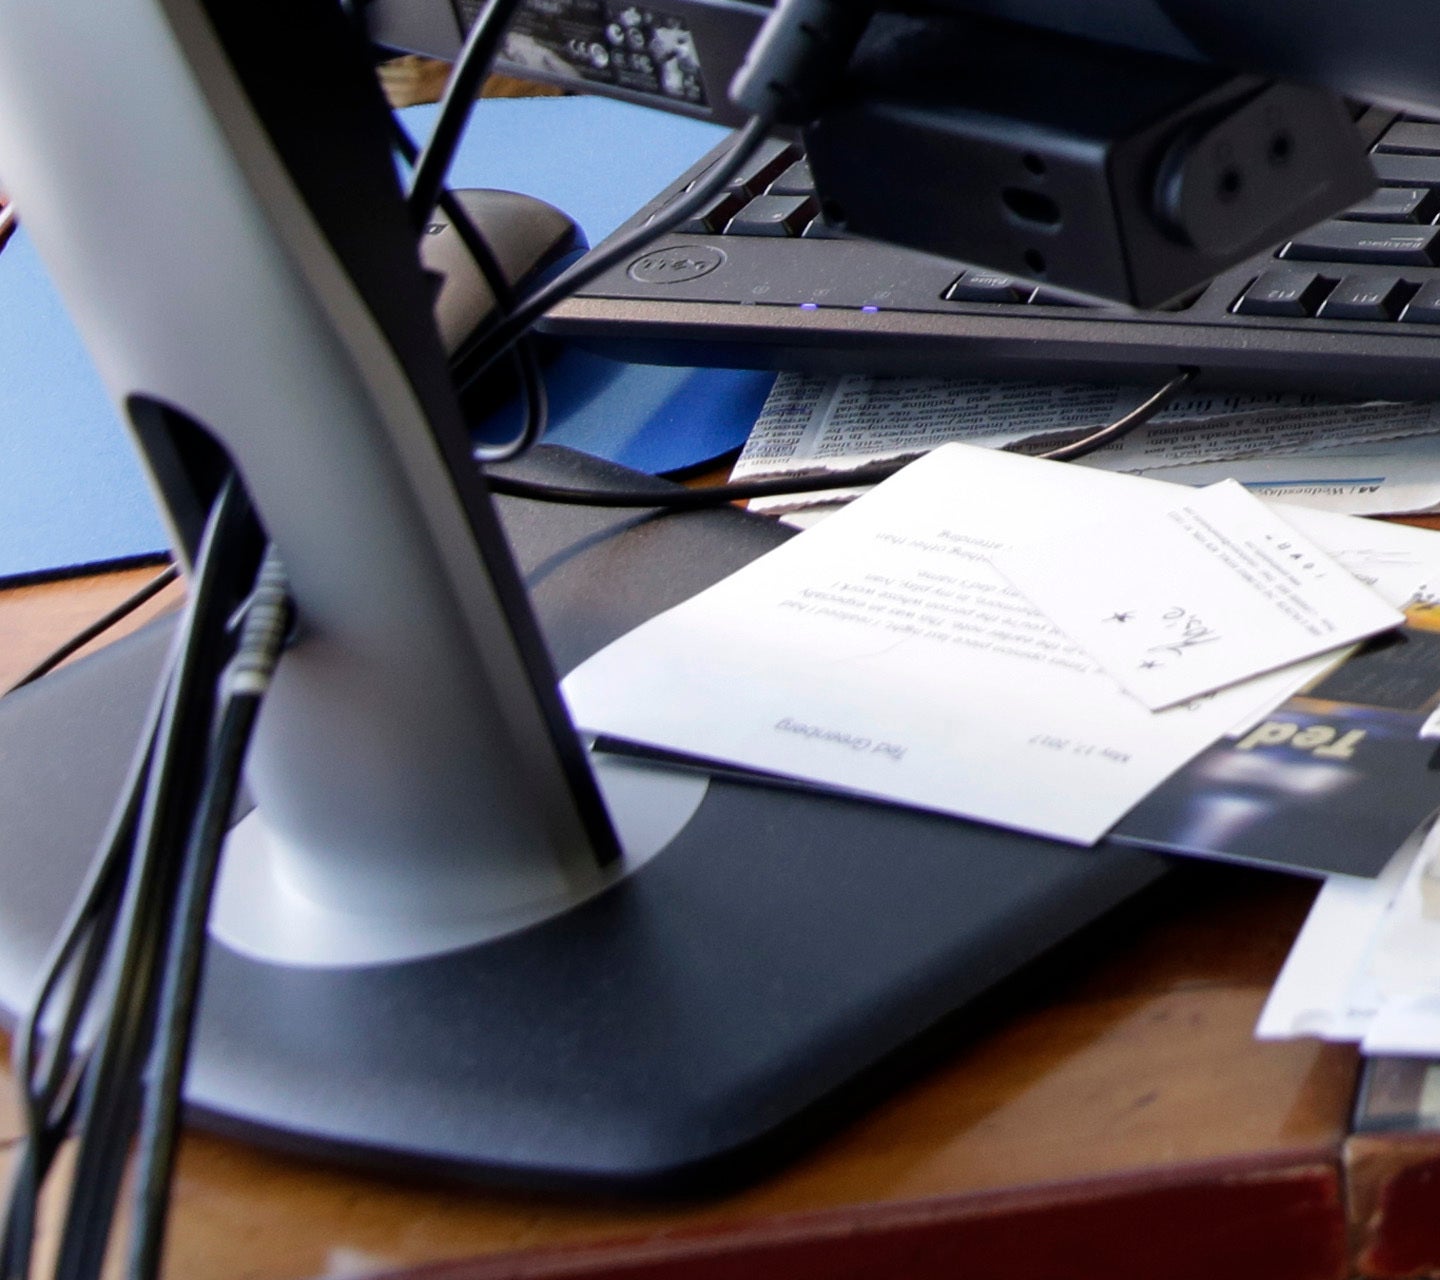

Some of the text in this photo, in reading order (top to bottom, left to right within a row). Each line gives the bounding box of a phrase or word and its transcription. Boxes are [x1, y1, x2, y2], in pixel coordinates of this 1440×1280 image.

[1357, 240, 1422, 249] Backspace
[775, 718, 908, 761] Ted Greenberg
[1234, 719, 1368, 761] Ted
